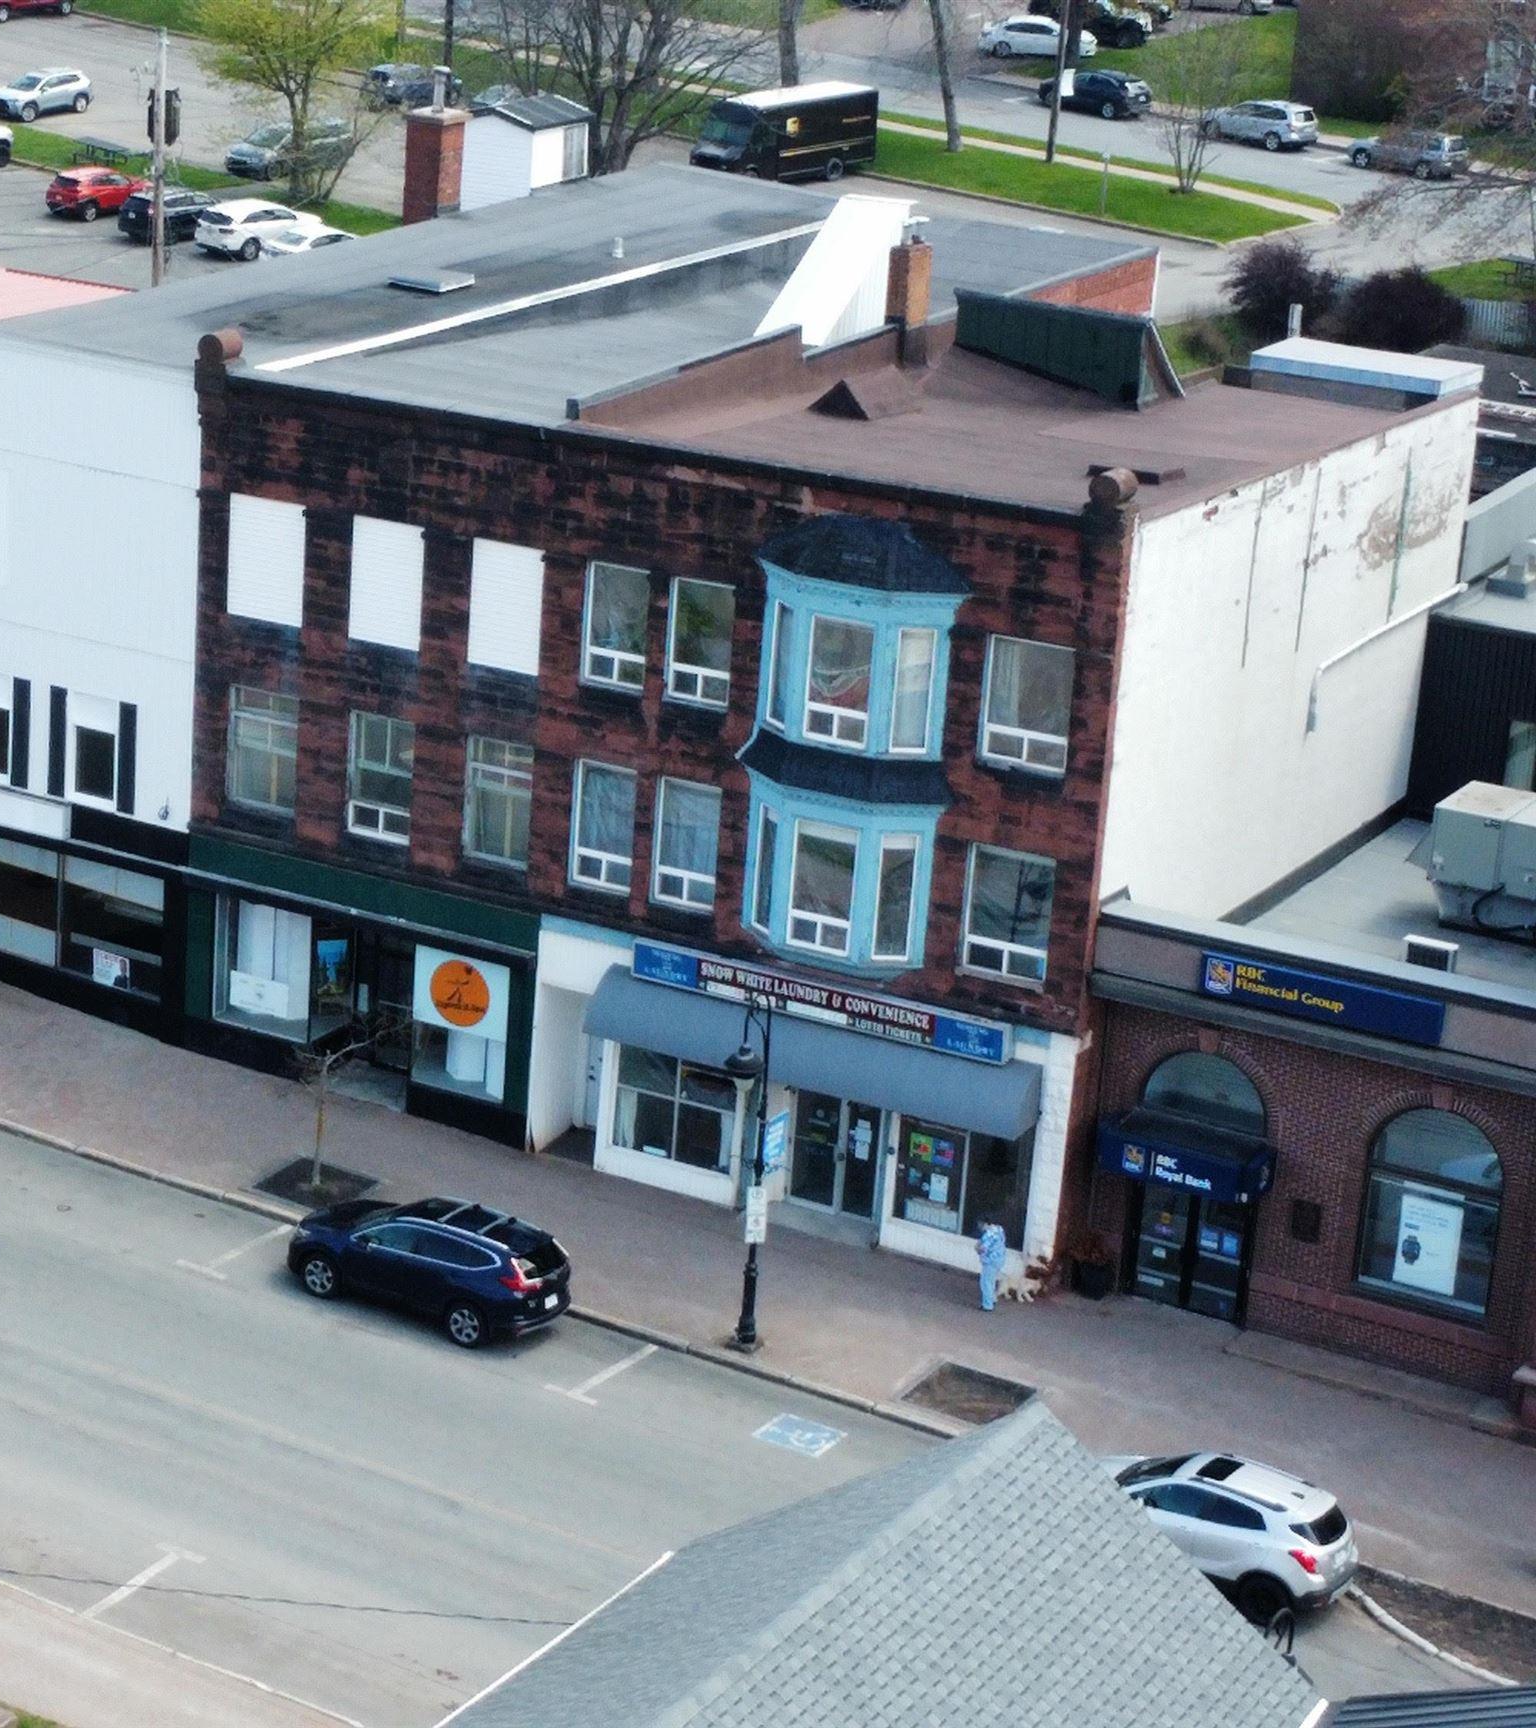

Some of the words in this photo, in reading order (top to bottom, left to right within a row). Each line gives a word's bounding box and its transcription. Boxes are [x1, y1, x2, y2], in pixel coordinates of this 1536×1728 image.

[1236, 964, 1266, 982] RBC
[700, 961, 734, 982] SNOW
[736, 969, 772, 992] WHITE
[774, 976, 829, 1005] LAUNDRY
[844, 997, 930, 1030] CONVENIENCE
[1235, 977, 1298, 1001] Financial
[1301, 992, 1344, 1013] Group
[1156, 1154, 1178, 1170] RBC
[1155, 1165, 1184, 1184] Royal
[1185, 1173, 1213, 1191] Bank
